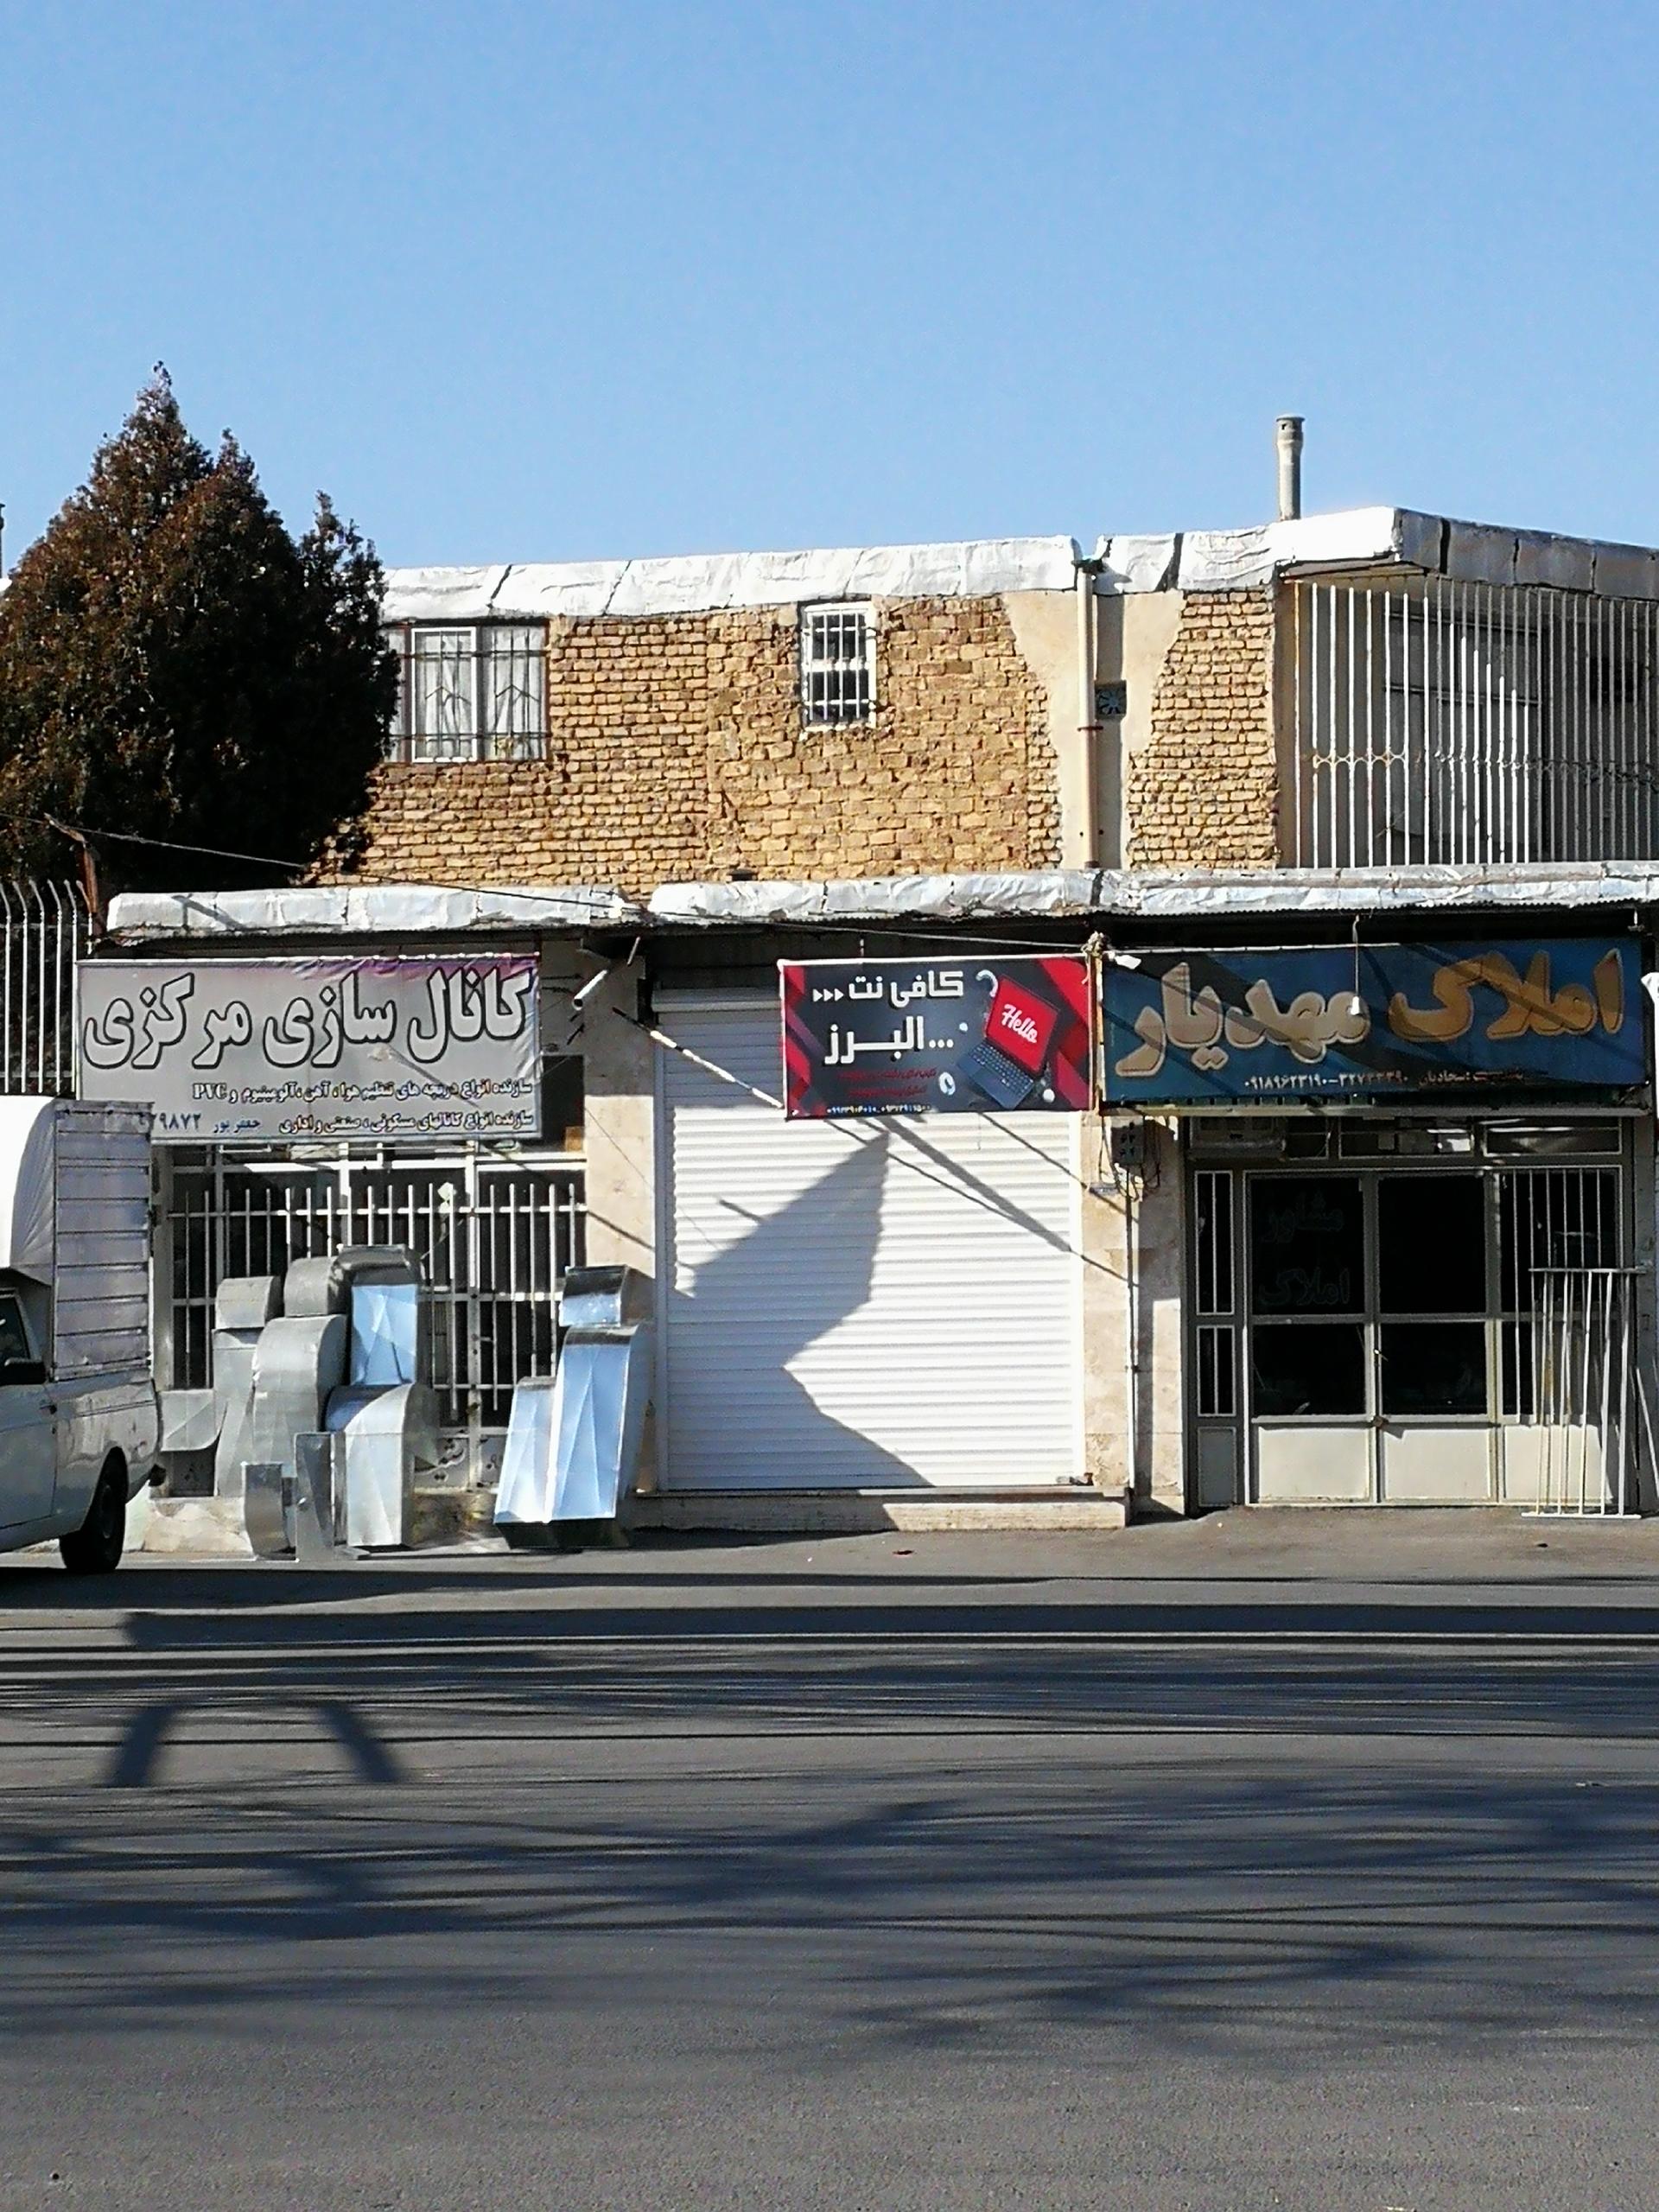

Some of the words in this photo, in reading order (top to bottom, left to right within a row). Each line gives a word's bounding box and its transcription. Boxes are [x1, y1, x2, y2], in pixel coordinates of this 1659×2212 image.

[849, 976, 883, 1001] نت
[891, 970, 964, 1007] کافی
[1388, 948, 1624, 1045] املاک
[84, 972, 253, 1070] مرکزی
[263, 969, 397, 1069] سازی
[408, 967, 533, 1064] کانال
[1001, 1003, 1038, 1044] Hello
[192, 1083, 227, 1099] PVC
[228, 1089, 238, 1104] و
[396, 1080, 421, 1101] های
[461, 1079, 491, 1099] انواع
[492, 1078, 532, 1097] سازنده
[464, 1110, 494, 1130] انواع
[494, 1109, 533, 1129] سازنده
[1258, 1265, 1351, 1306] املاک
